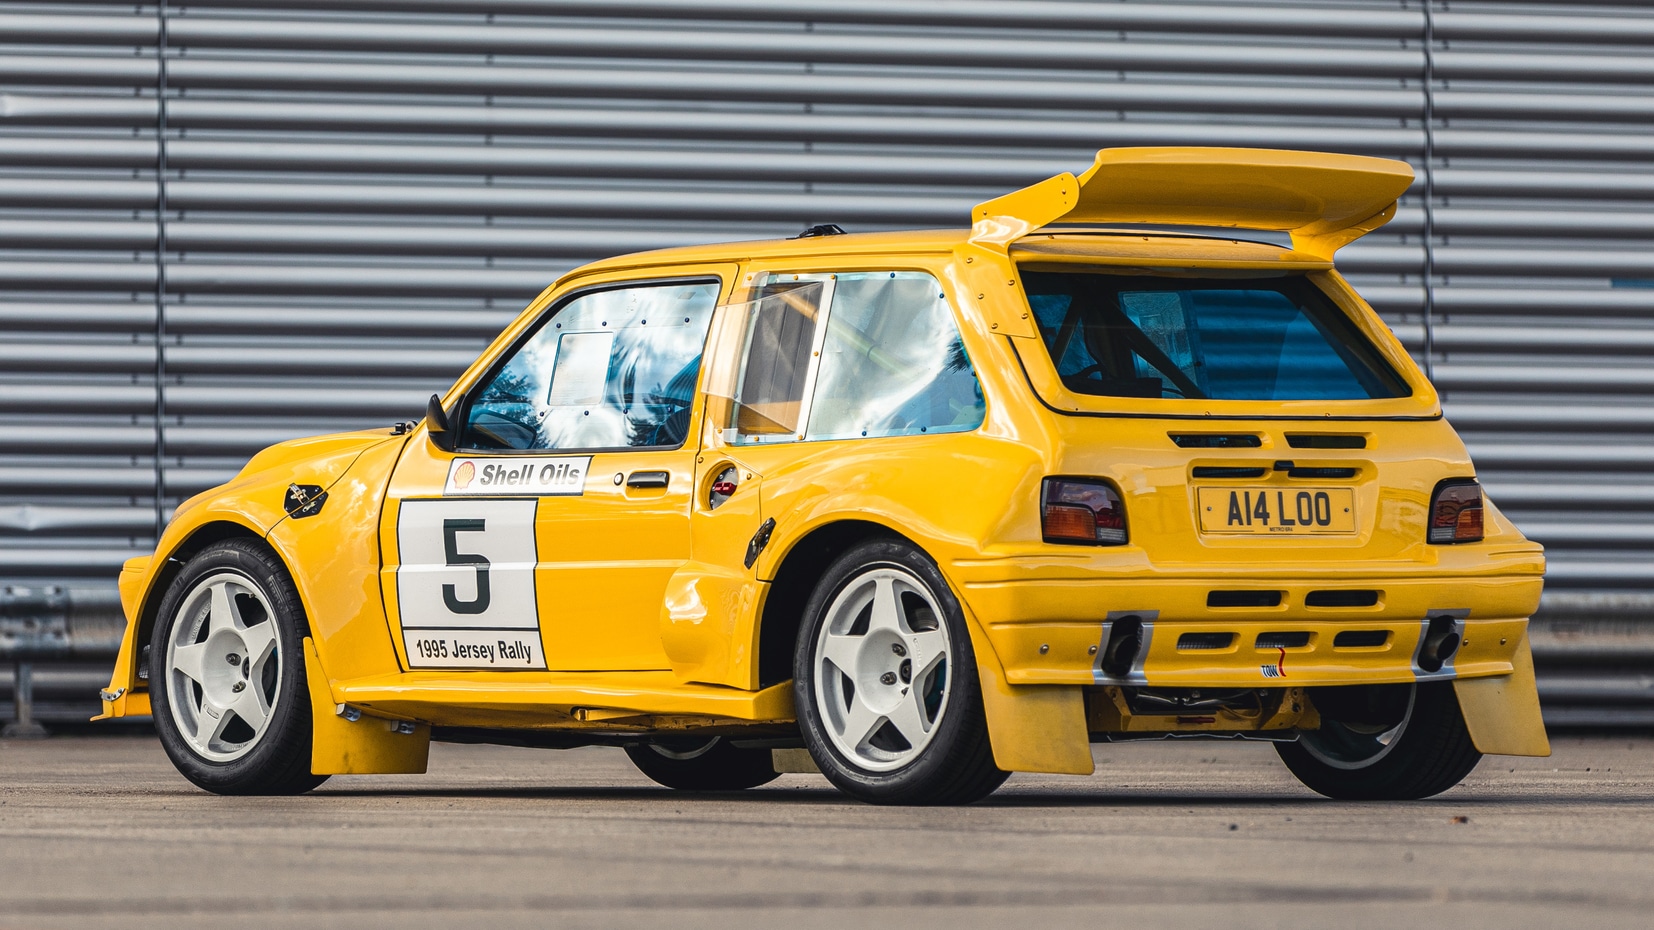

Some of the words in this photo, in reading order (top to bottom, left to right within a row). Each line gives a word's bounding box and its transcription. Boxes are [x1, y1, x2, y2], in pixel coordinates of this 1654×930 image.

[480, 464, 535, 486] Shell
[540, 464, 580, 485] Oils
[1227, 491, 1270, 526] A14
[442, 518, 491, 614] 5
[416, 639, 448, 659] 1995
[452, 639, 495, 663] Jersey
[497, 640, 532, 664] Rally
[1261, 665, 1279, 677] TOW
